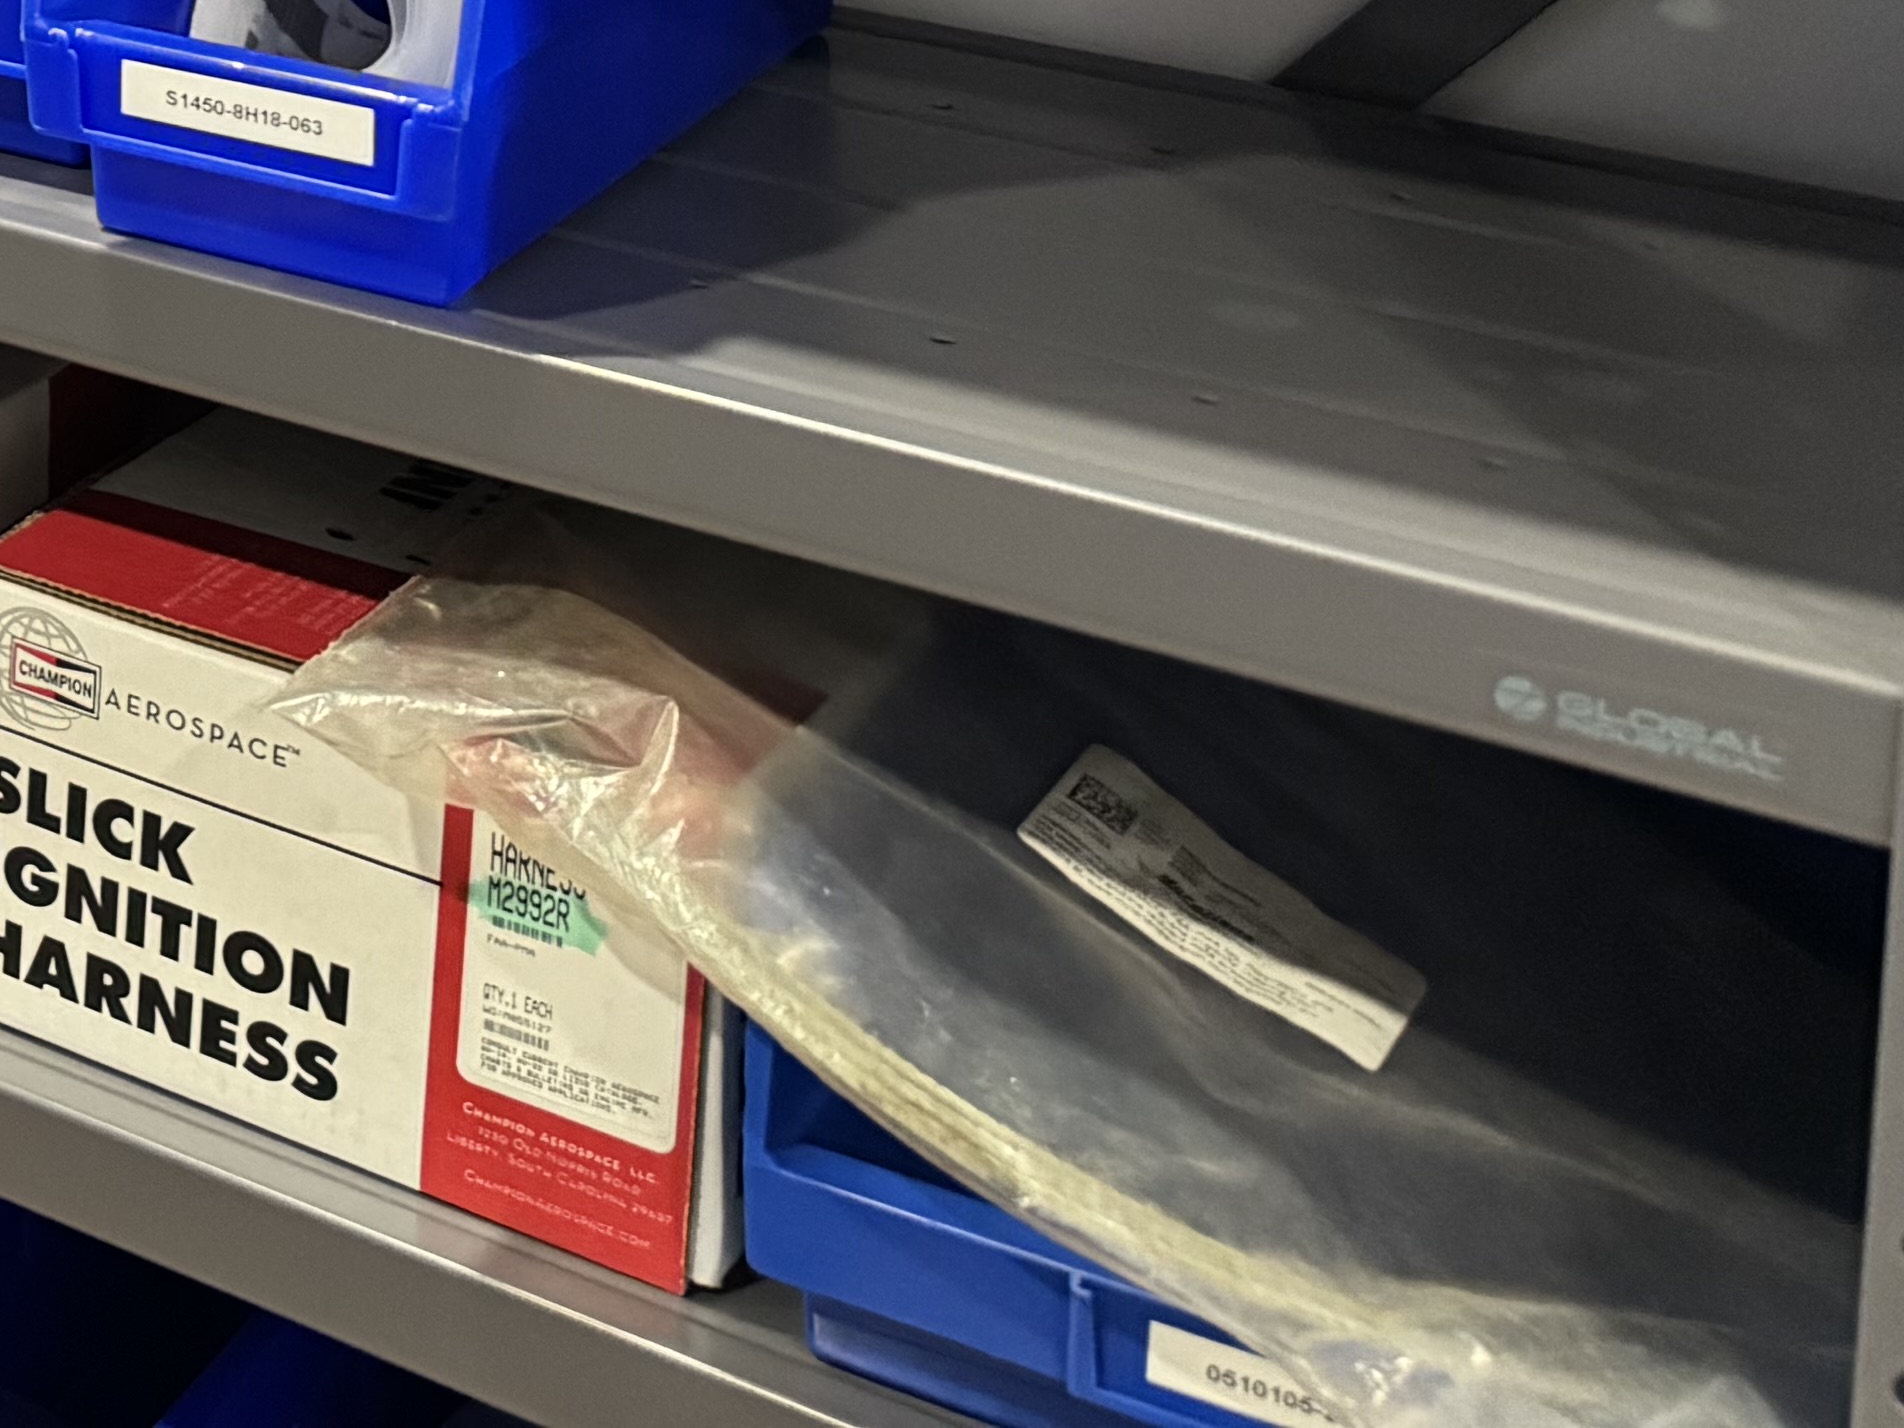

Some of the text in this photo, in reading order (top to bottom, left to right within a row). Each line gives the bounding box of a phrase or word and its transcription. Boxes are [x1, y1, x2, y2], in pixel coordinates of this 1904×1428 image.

[165, 89, 324, 137] S1450-8H18-063
[19, 659, 92, 700] CHAMPION
[488, 875, 570, 933] M2992R
[523, 995, 554, 1020] EACH
